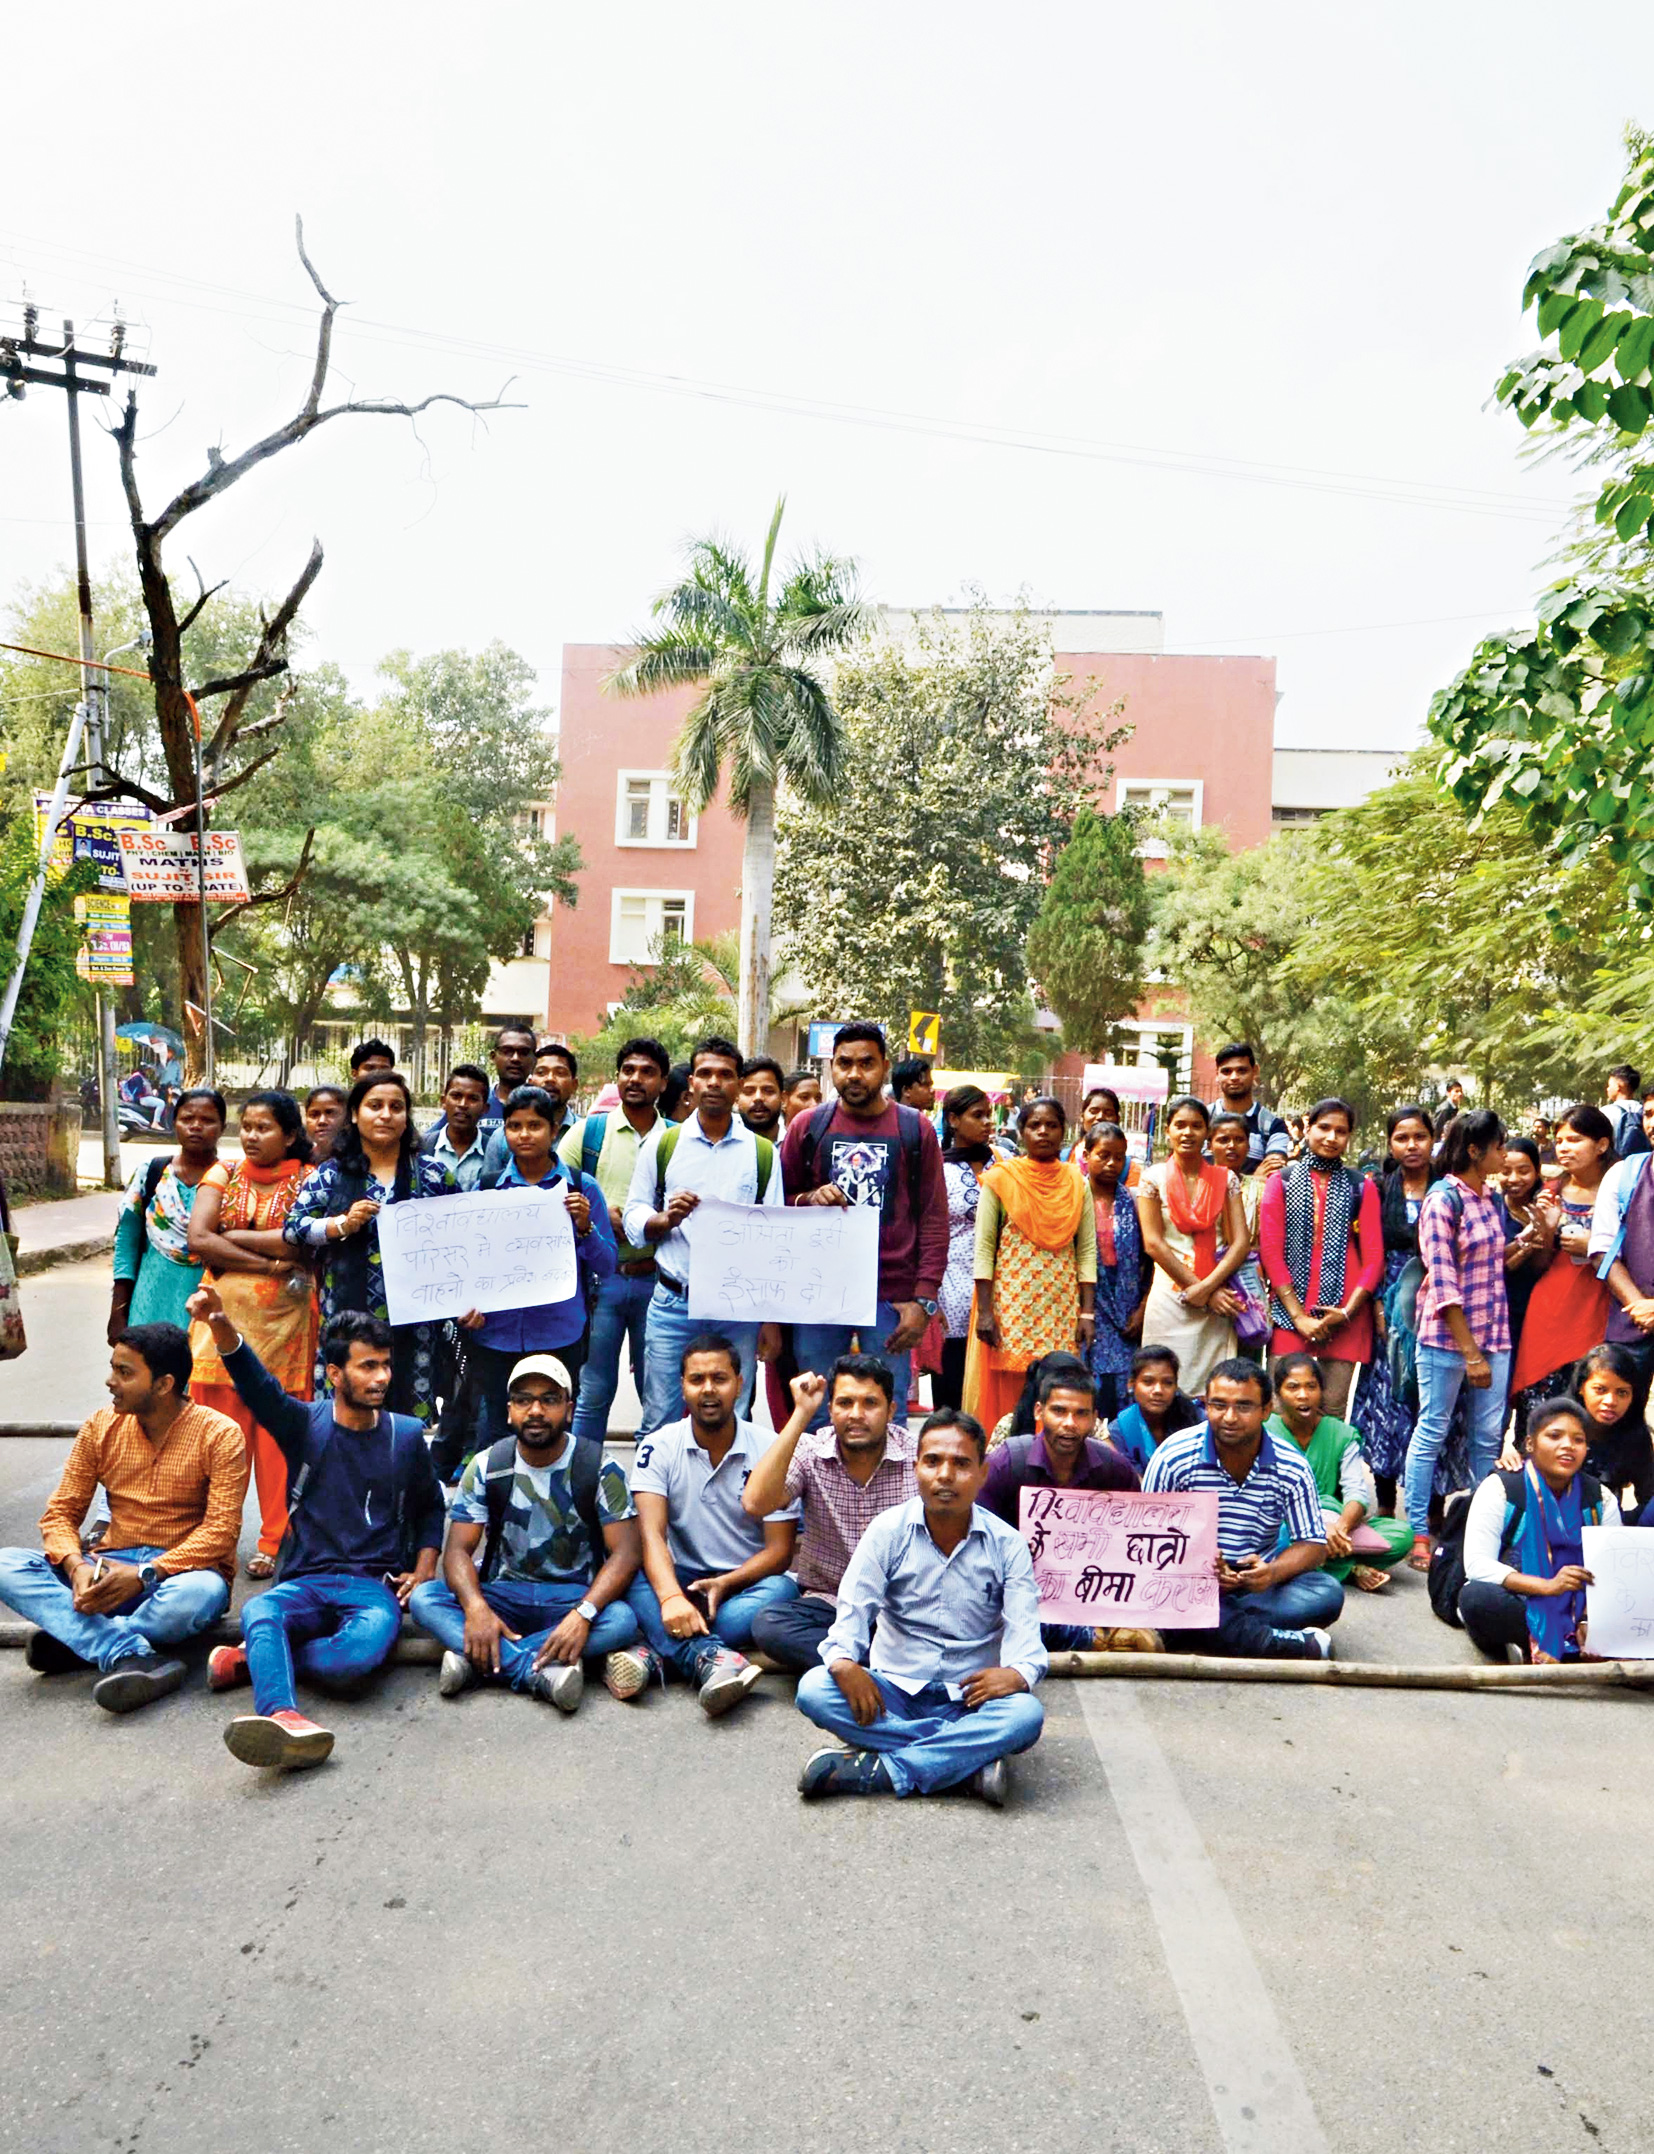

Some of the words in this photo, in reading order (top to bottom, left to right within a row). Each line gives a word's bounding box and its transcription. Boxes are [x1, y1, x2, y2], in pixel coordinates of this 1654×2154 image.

[96, 805, 146, 817] CLASSES
[120, 834, 167, 850] B.Sc
[190, 834, 237, 850] B.Sc
[139, 858, 224, 867] MATHS
[131, 872, 194, 881] SUJIT
[203, 872, 236, 880] SIR
[636, 1444, 655, 1469] 3
[1074, 1565, 1136, 1603] बीमा
